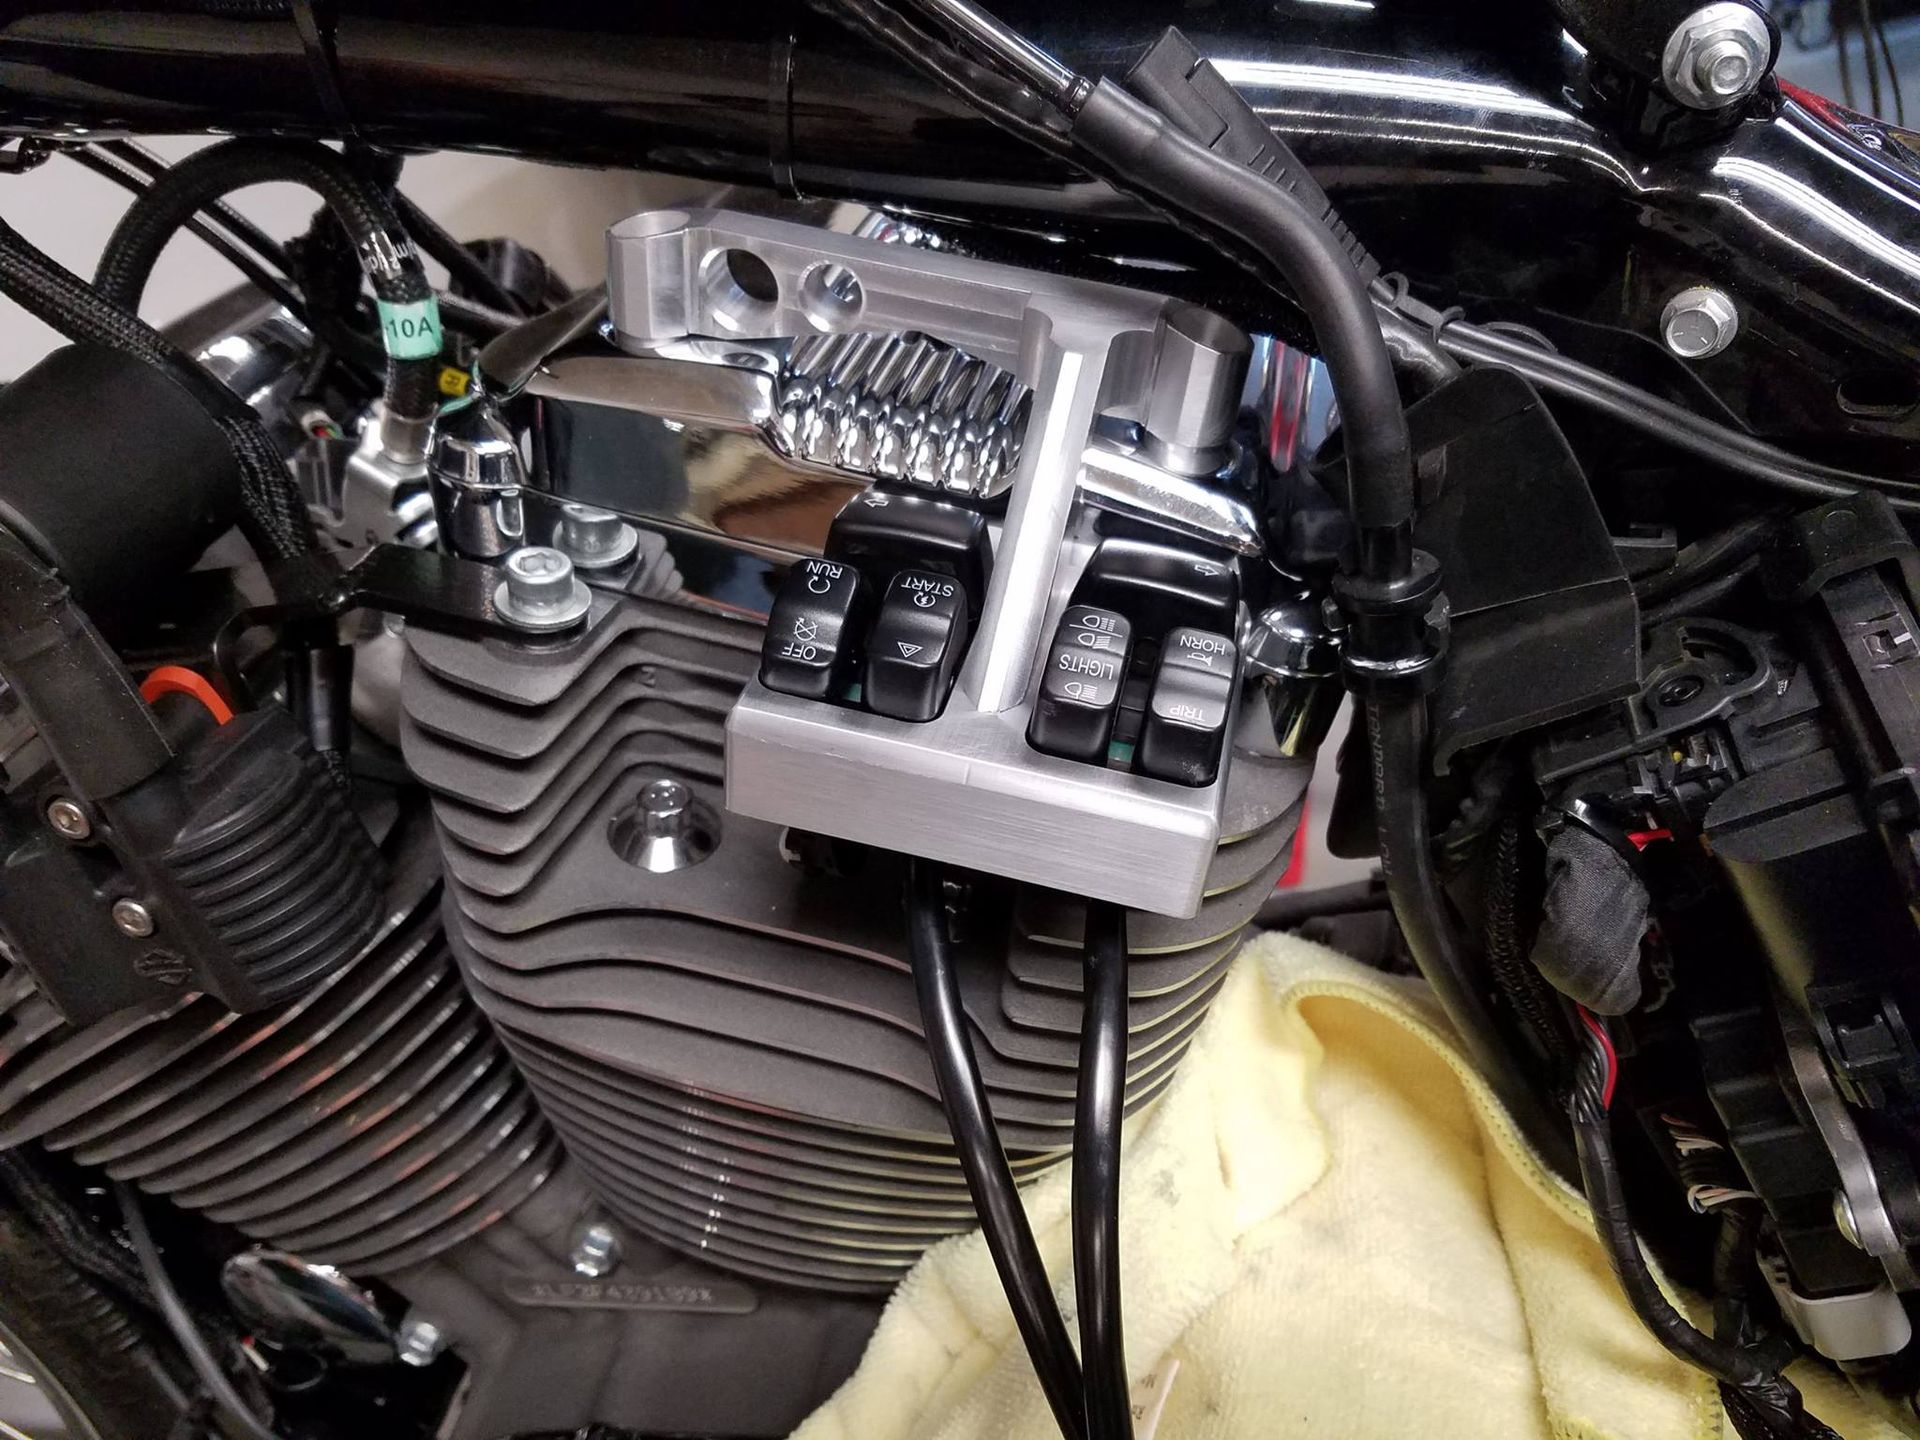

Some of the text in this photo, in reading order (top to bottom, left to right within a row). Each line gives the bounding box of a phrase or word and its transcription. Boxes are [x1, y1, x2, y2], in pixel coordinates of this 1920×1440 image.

[806, 561, 843, 579] RUN
[901, 576, 954, 597] START
[781, 642, 816, 660] OFF
[1180, 635, 1226, 655] HORN
[1059, 654, 1114, 680] LIGHTS
[1169, 704, 1206, 722] TRIP
[1367, 704, 1386, 811] TANDARD
